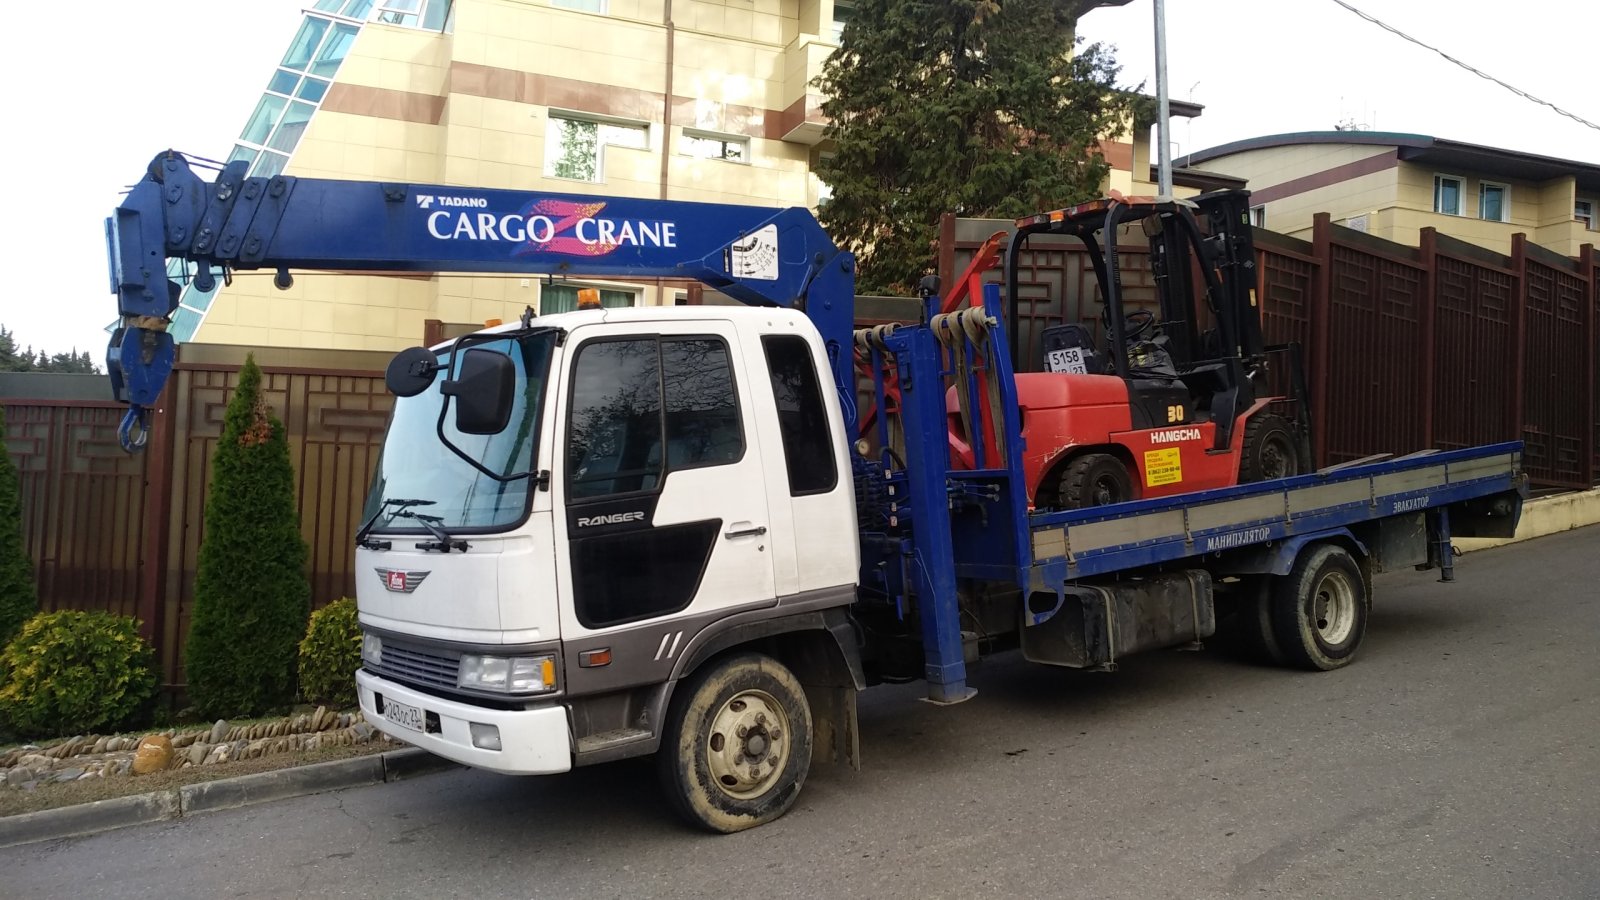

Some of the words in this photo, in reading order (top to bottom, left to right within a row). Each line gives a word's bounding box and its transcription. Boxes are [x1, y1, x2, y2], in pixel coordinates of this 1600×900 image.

[438, 196, 488, 208] TADANO
[427, 211, 555, 242] CARGO
[575, 217, 677, 248] CRANE
[1052, 350, 1080, 366] 5158
[1167, 404, 1184, 423] 30
[1150, 428, 1201, 444] HANGCHA
[1393, 496, 1430, 514] ЭВАКУАТОР
[577, 511, 645, 527] RANGER
[1207, 527, 1271, 551] МАНИПУЛЯТОР
